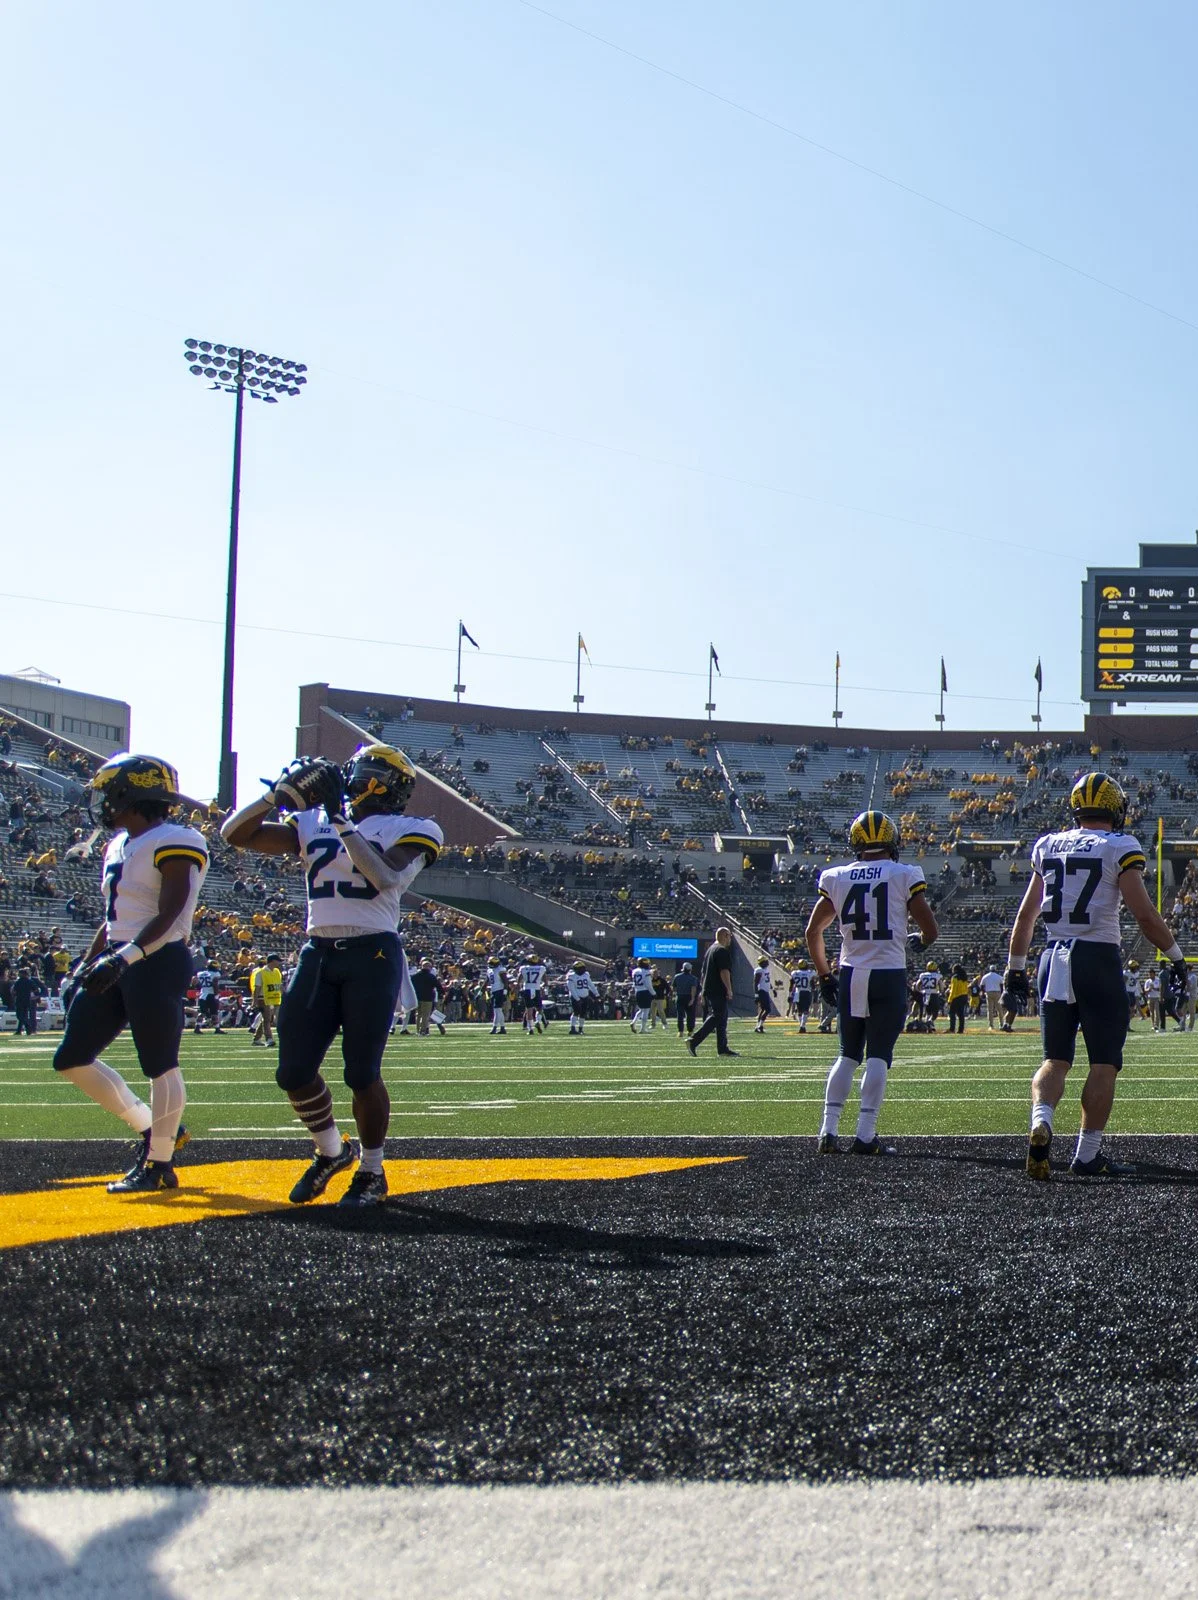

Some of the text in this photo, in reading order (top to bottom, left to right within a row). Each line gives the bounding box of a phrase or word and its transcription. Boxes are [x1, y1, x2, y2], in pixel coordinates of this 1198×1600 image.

[1129, 587, 1136, 598] 0
[1188, 587, 1195, 598] 0
[1122, 611, 1131, 620] &
[1146, 629, 1178, 637] RUSH YARDS
[1146, 645, 1178, 653] PASS YARDS
[1145, 660, 1178, 668] TOTAL YARDS
[1117, 673, 1182, 683] XTREAM
[850, 867, 882, 880] GASH
[106, 862, 123, 921] 7
[1041, 858, 1103, 924] 37
[841, 882, 893, 940] 41
[200, 977, 213, 987] 26
[527, 972, 540, 983] 17
[795, 976, 808, 988] 20
[922, 977, 936, 989] 23
[576, 979, 589, 989] 99
